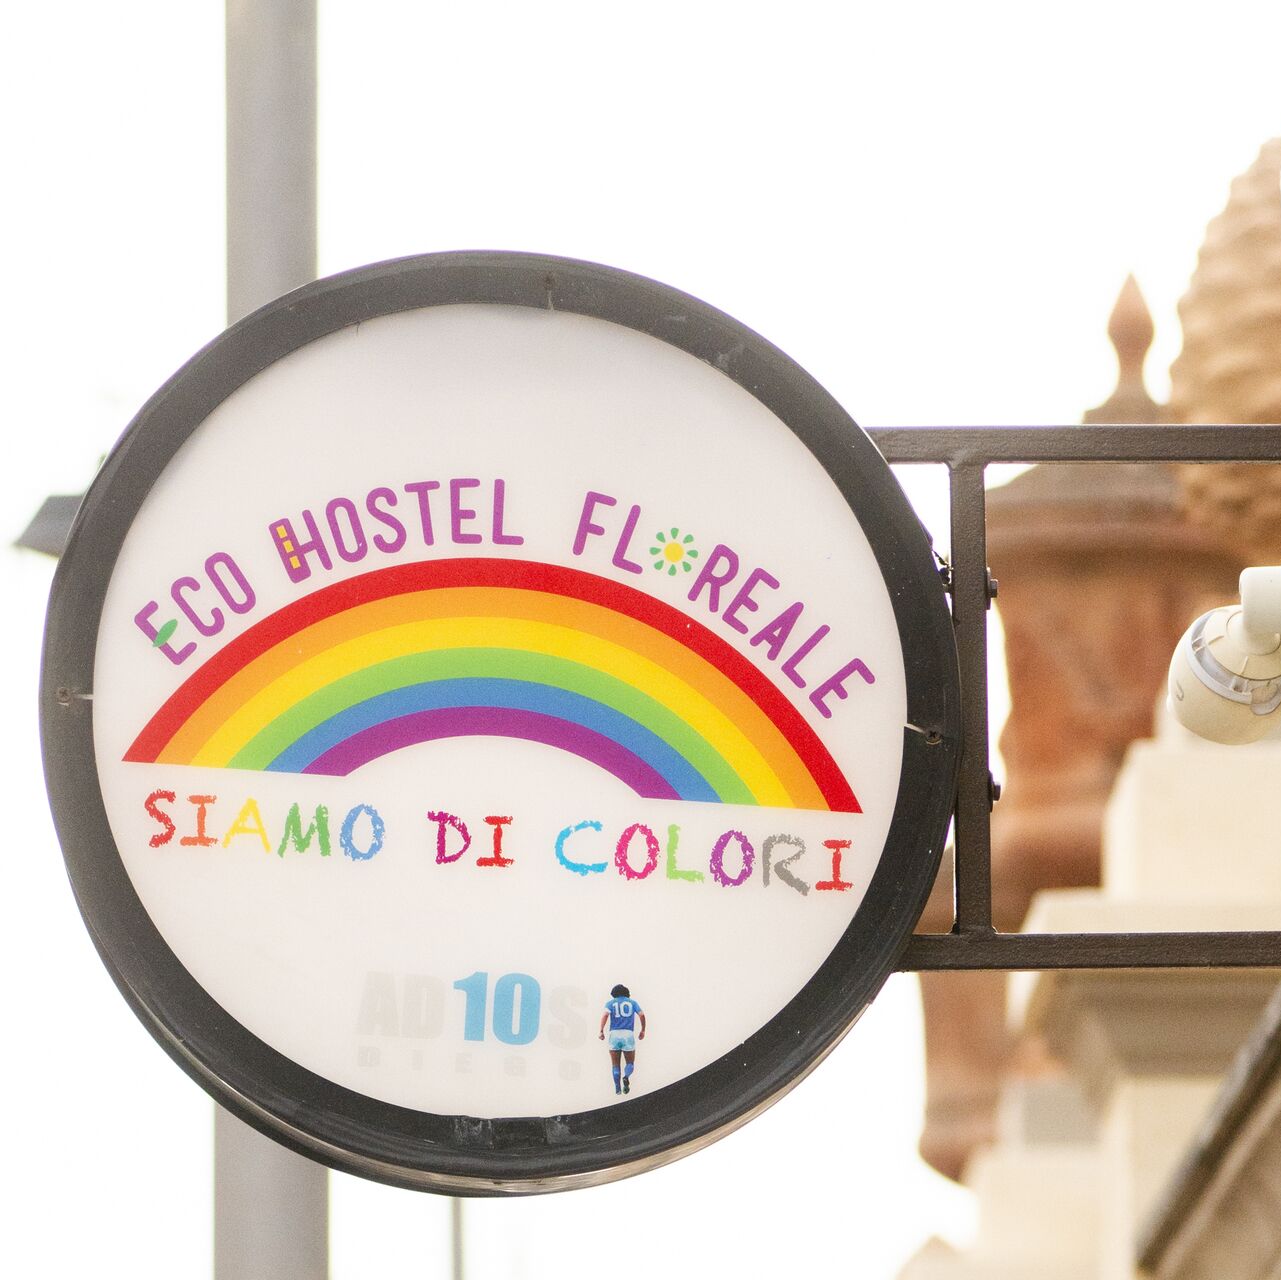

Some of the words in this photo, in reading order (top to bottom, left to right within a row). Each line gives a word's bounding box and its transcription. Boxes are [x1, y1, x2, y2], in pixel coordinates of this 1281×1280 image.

[134, 551, 257, 665] ECO
[268, 478, 525, 584] HOSTEL
[143, 788, 386, 862] SIAMO
[427, 810, 515, 866] DI
[555, 820, 855, 898] COLORI
[612, 1000, 634, 1018] 10
